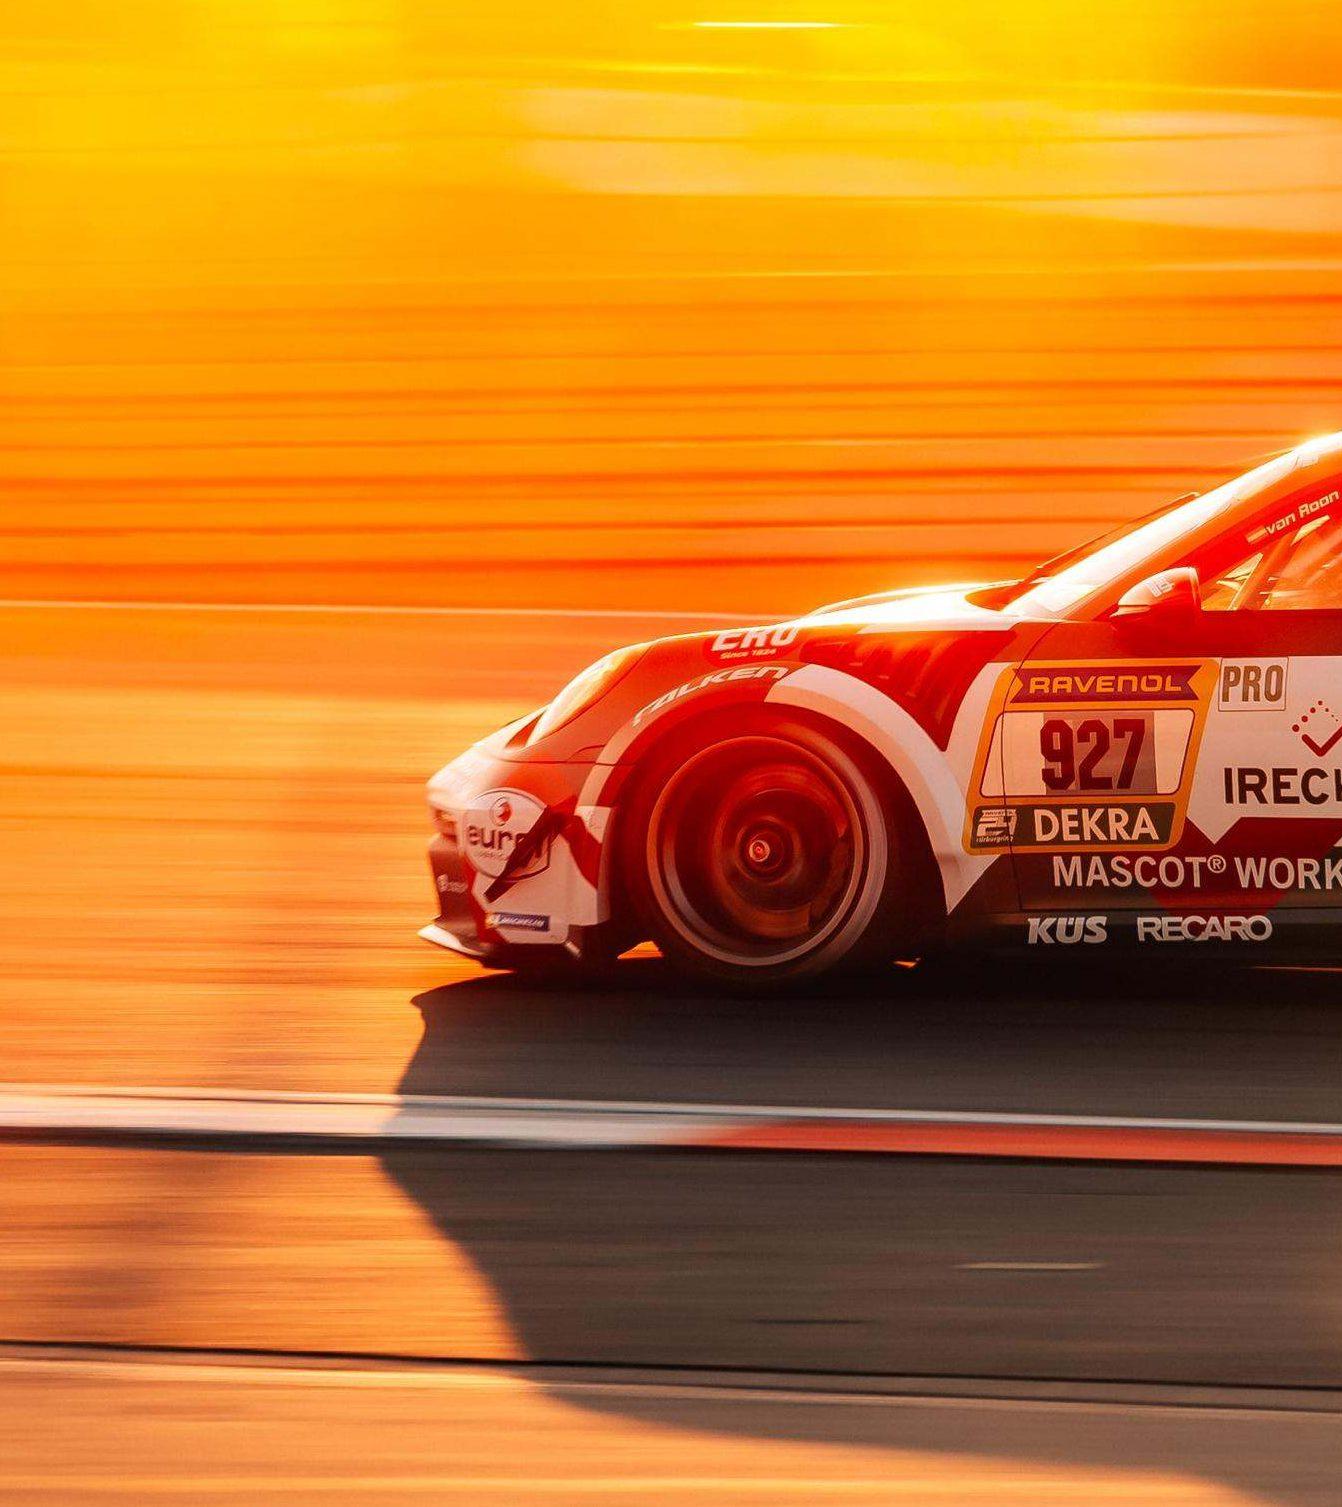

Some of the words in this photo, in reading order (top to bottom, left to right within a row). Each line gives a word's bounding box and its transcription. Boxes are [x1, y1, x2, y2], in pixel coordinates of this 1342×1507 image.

[1266, 512, 1296, 534] van
[631, 666, 789, 727] FALKEN
[1029, 674, 1182, 694] RAVENOL
[1221, 665, 1283, 702] PRO
[1040, 718, 1146, 791] 927
[1033, 807, 1160, 842] DEKRA
[1027, 916, 1108, 944] KÜS
[1136, 915, 1273, 942] RECARO
